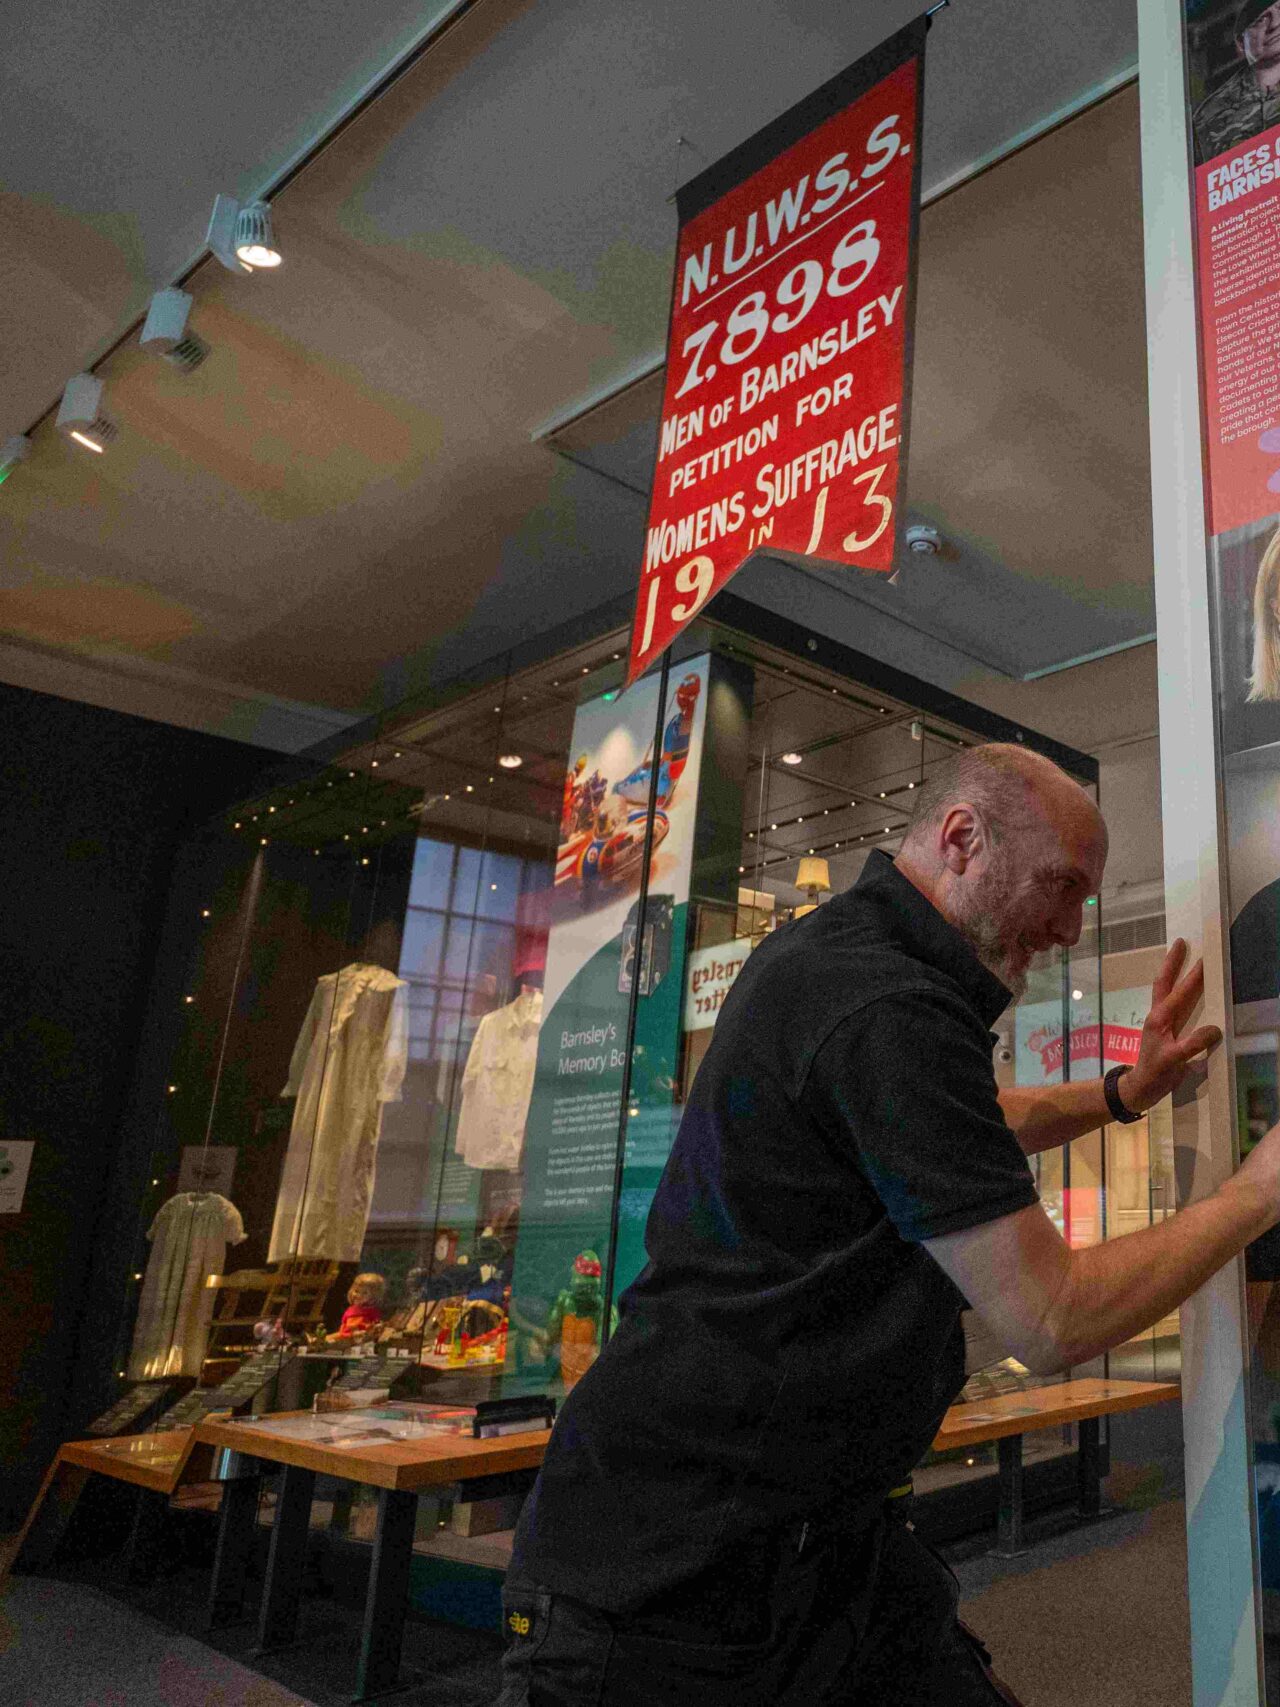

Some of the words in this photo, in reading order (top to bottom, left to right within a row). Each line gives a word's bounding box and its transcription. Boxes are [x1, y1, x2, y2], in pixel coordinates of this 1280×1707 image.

[681, 115, 911, 307] N.U.W.S.S.
[1207, 144, 1270, 192] FACES
[659, 406, 704, 462] MEN
[709, 396, 735, 428] OF
[739, 285, 903, 414] BARNSLEY
[669, 415, 778, 497] PETITION
[796, 373, 853, 427] FOR
[646, 491, 745, 573] WOMENS
[752, 404, 902, 518] SUFFRAGE.
[748, 517, 774, 550] IN
[638, 555, 715, 657] 19
[804, 463, 892, 555] 13
[558, 1052, 607, 1077] Memory
[560, 1023, 616, 1050] Barnsley's
